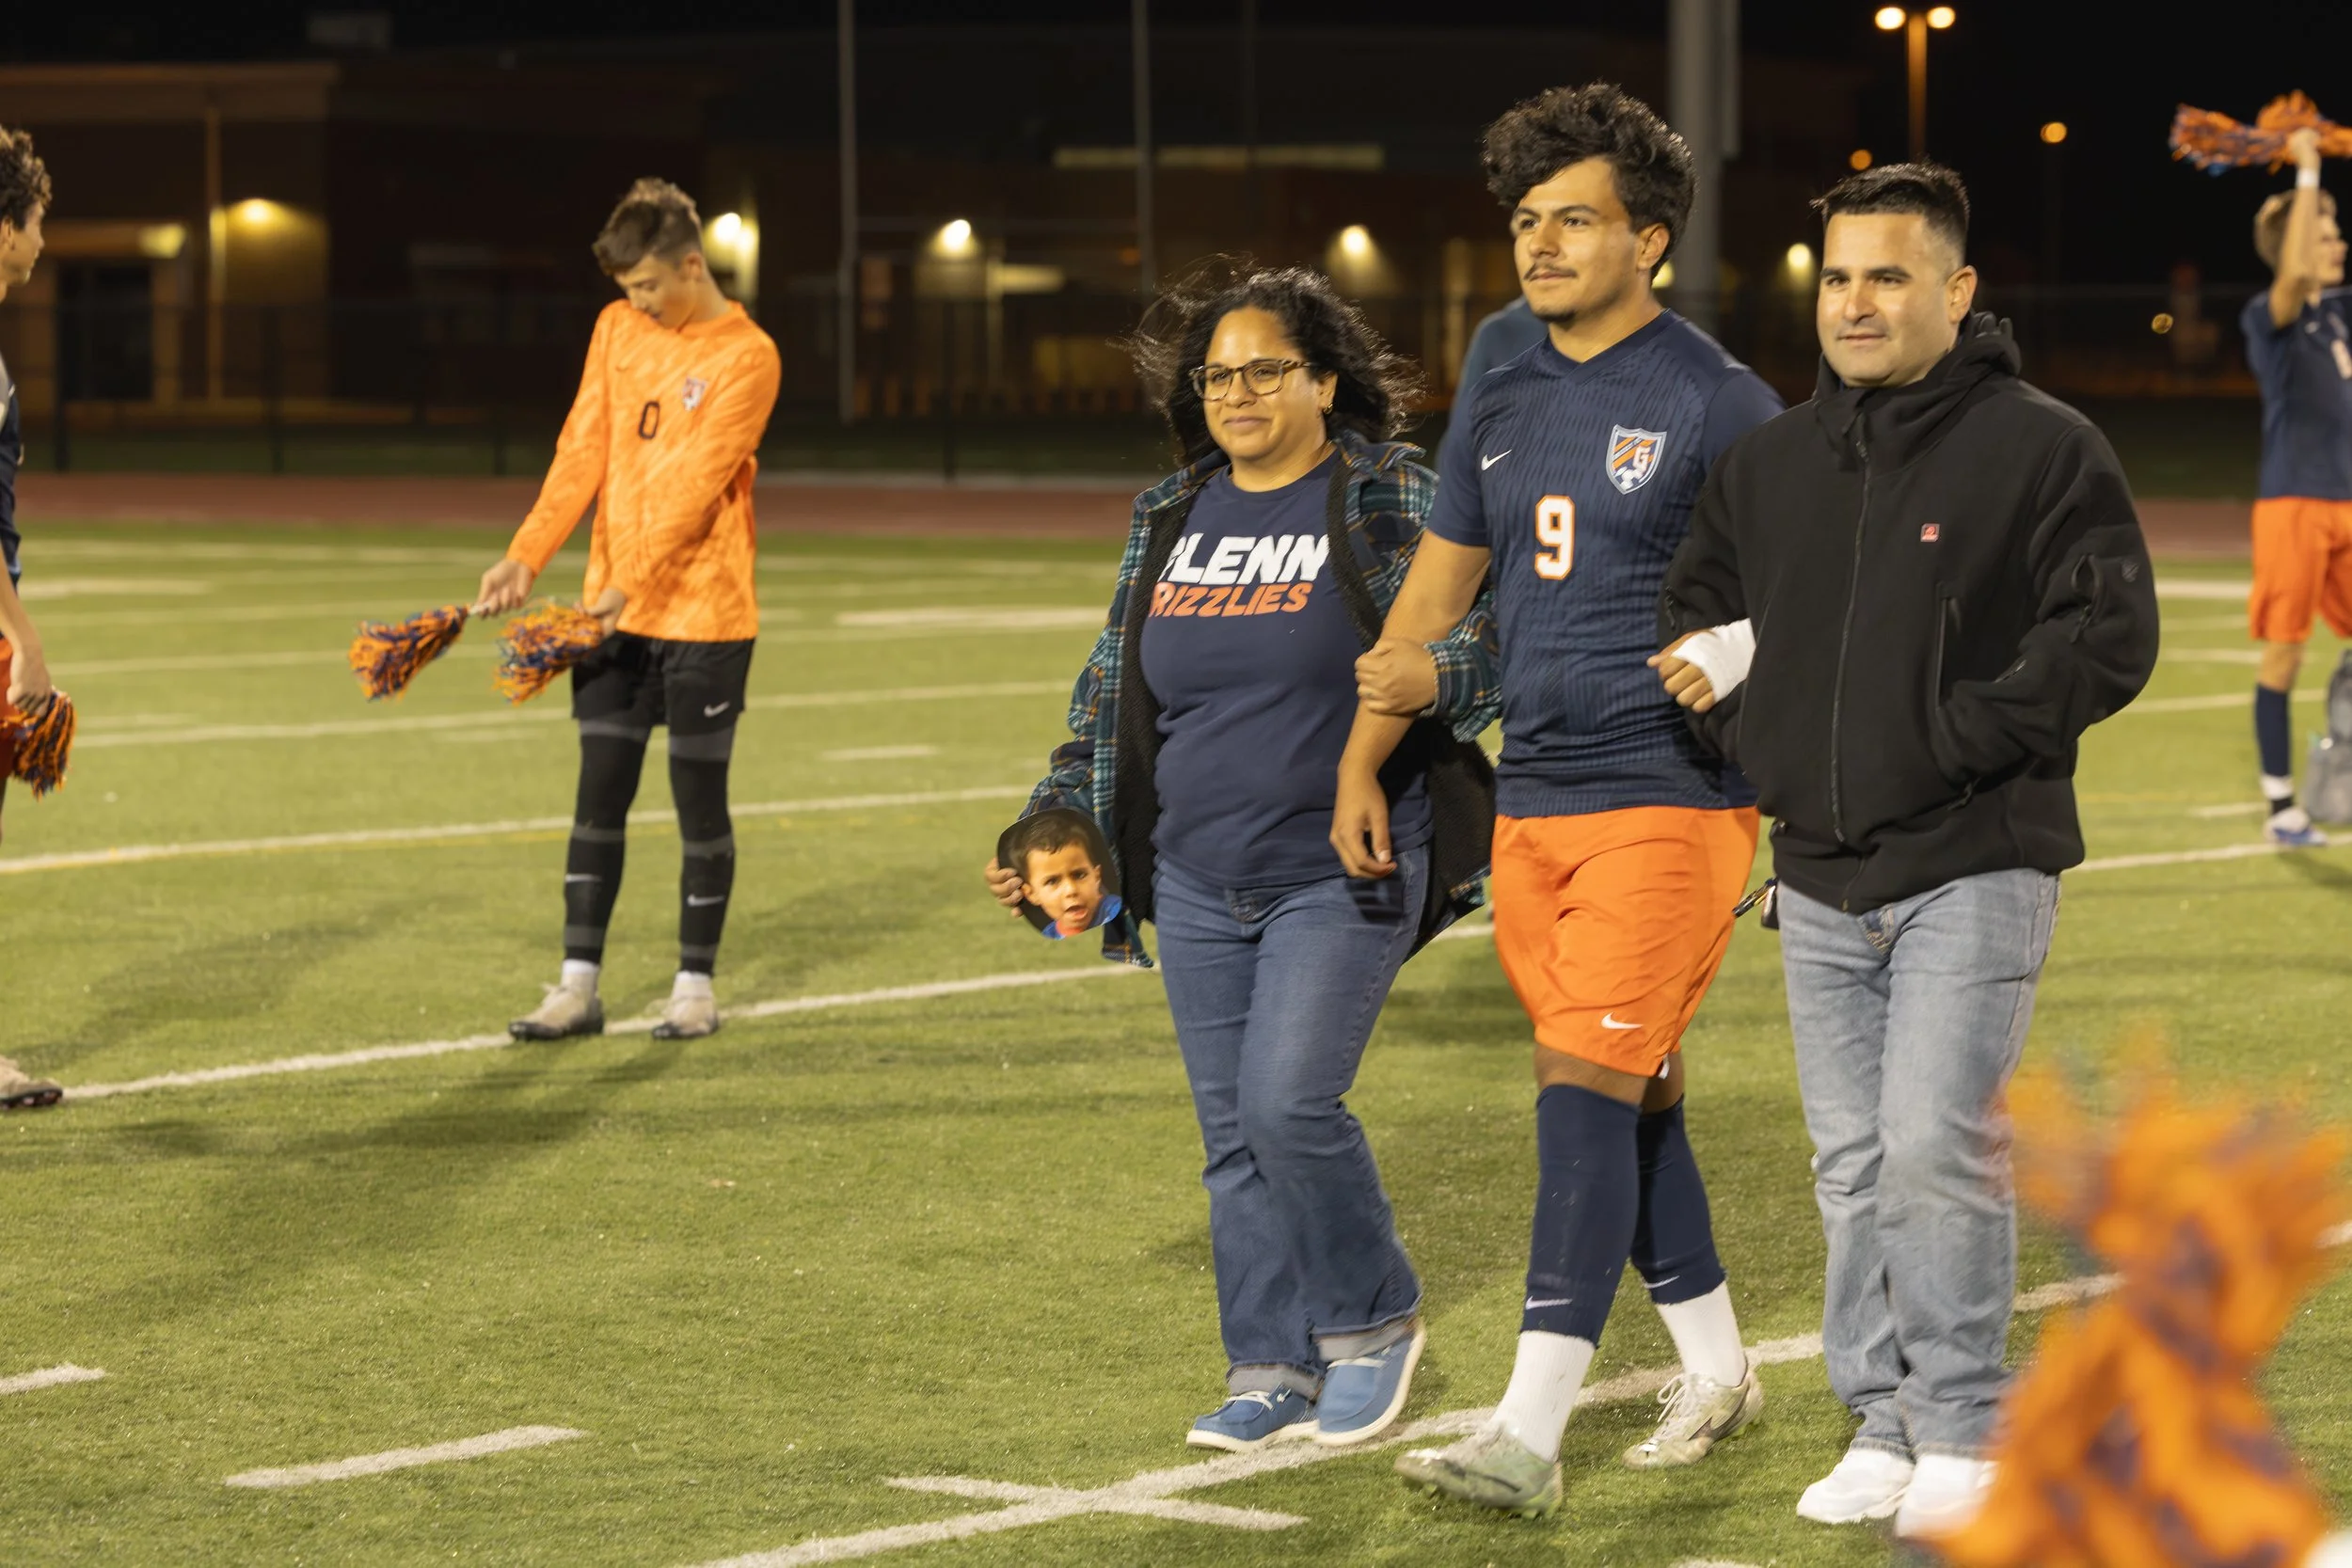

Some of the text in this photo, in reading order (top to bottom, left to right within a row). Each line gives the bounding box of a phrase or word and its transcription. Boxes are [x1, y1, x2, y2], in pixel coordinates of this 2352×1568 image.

[638, 400, 660, 440] 0
[1534, 495, 1576, 581] 9
[1148, 581, 1313, 618] RIZZLIES
